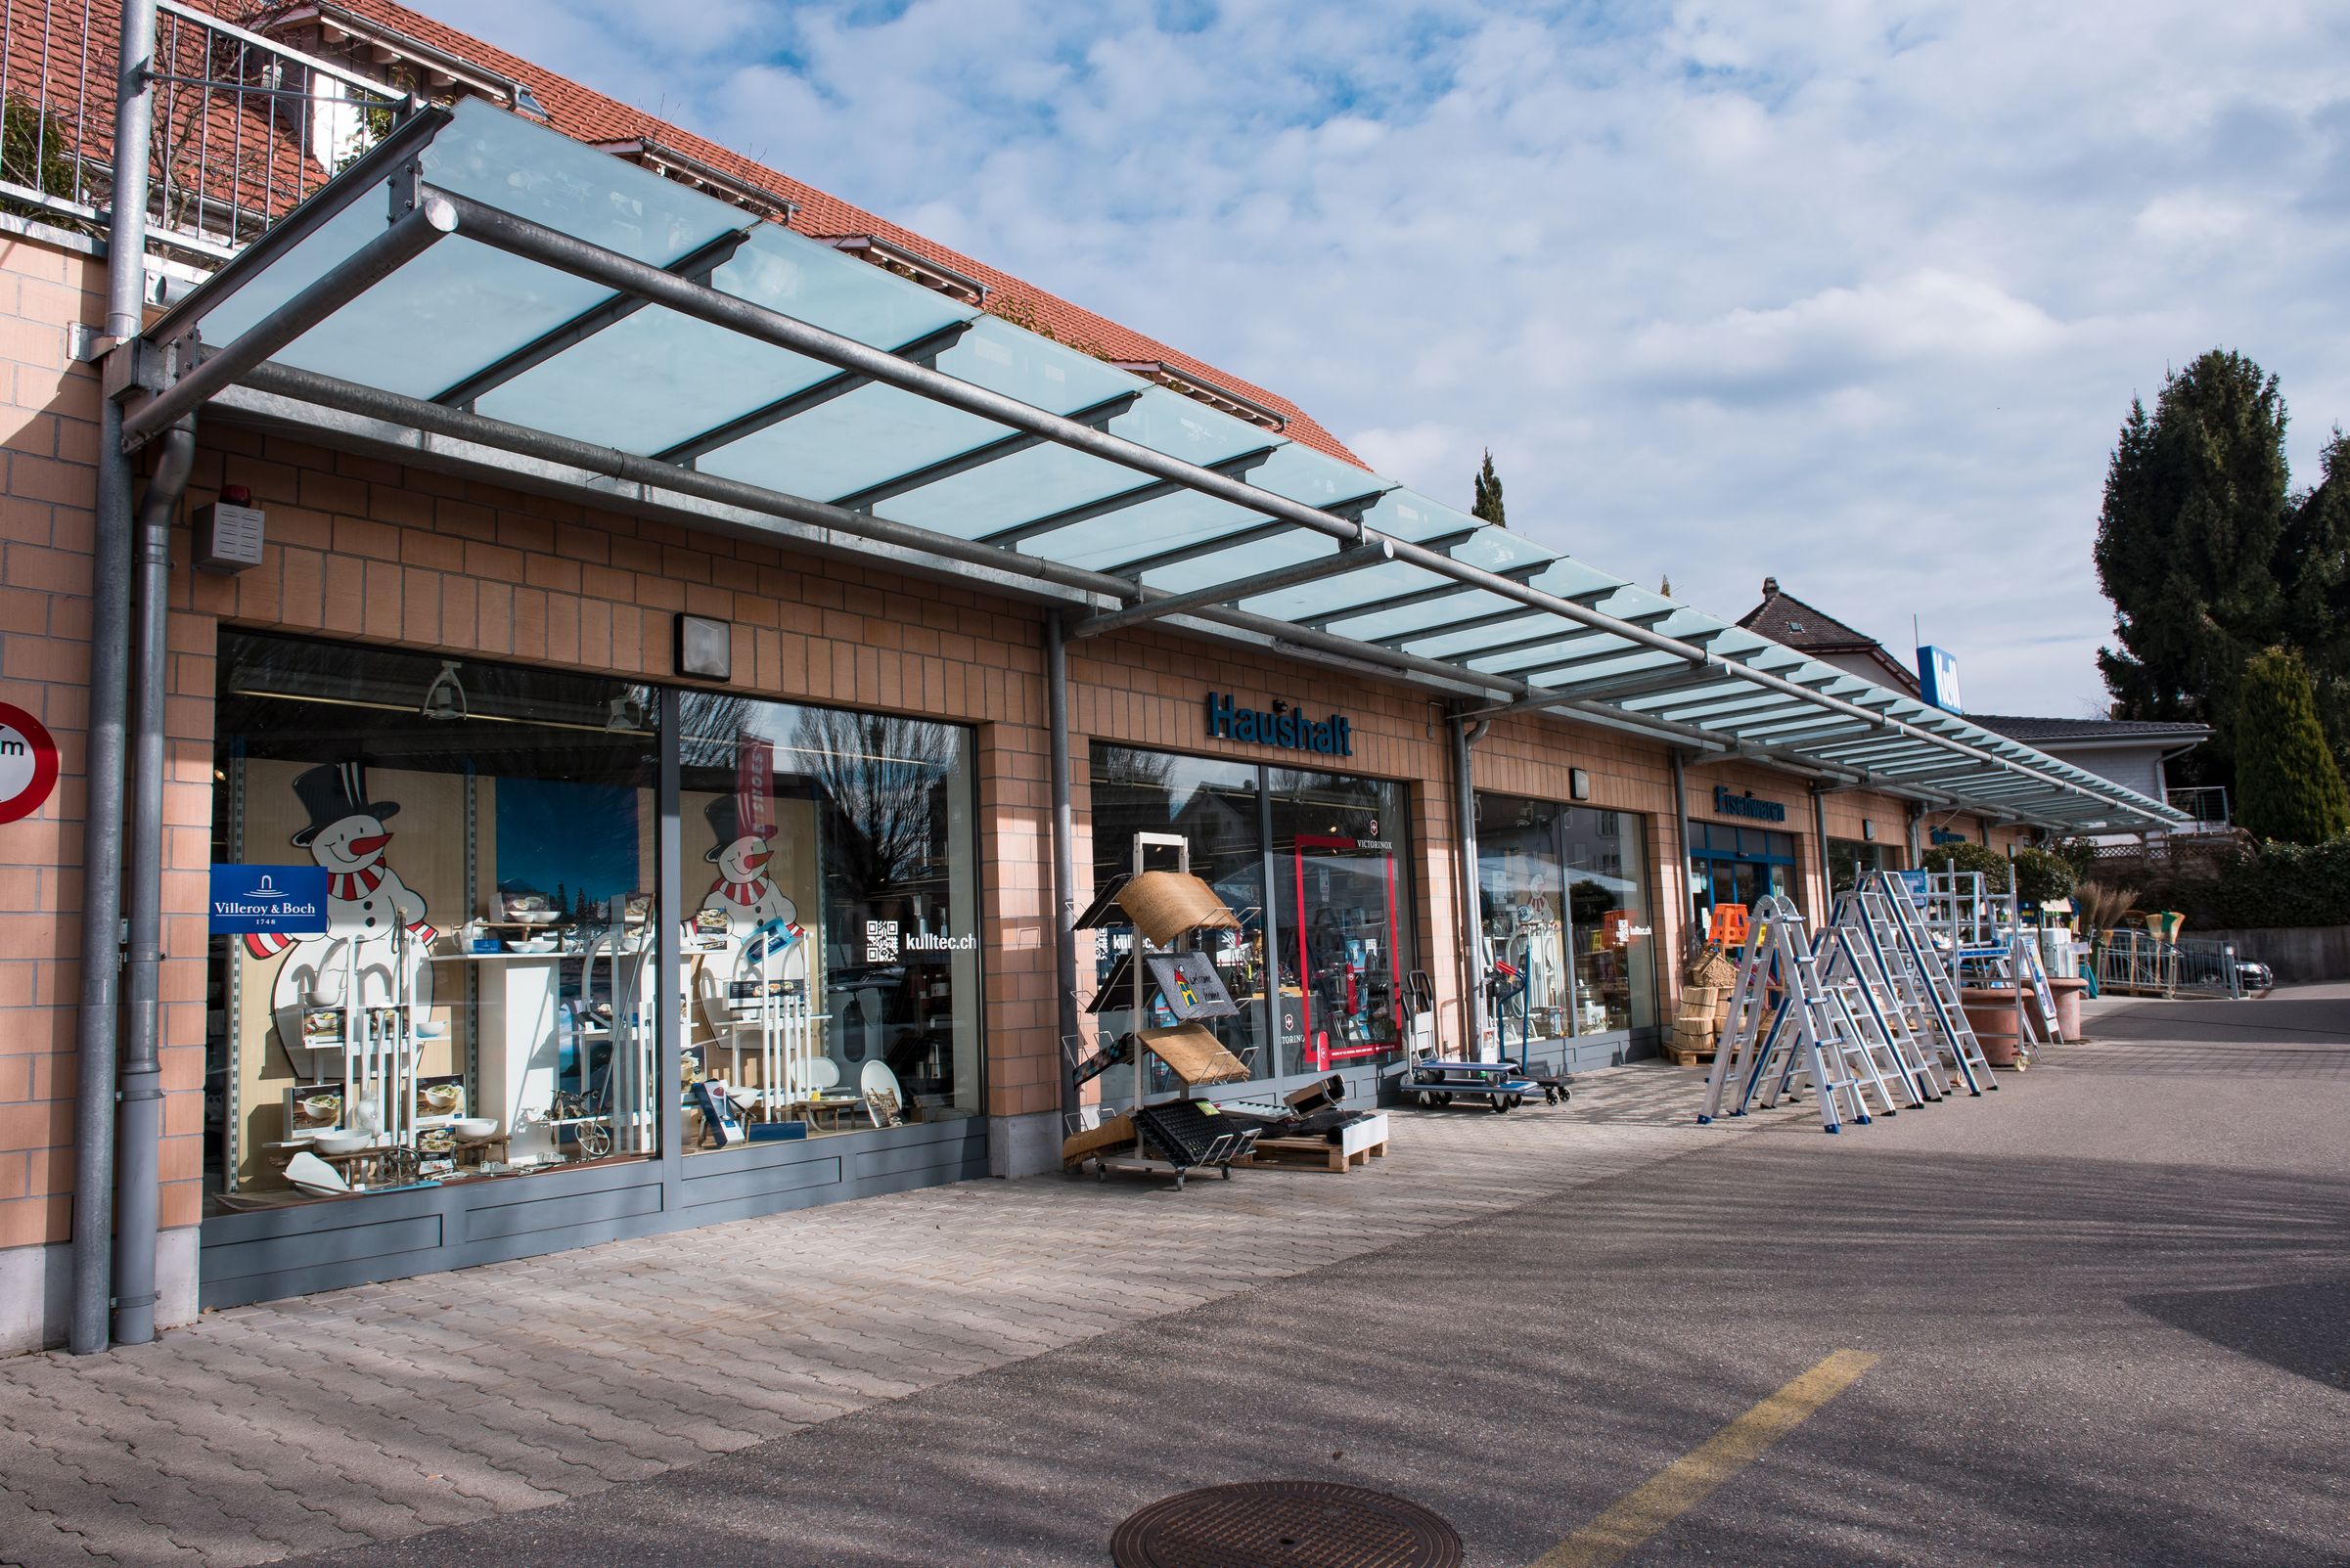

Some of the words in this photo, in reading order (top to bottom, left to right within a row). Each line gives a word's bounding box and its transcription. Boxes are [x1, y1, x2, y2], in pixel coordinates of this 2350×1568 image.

[1932, 650, 1962, 710] Kull
[1208, 692, 1353, 756] Haushalt
[1714, 785, 1785, 822] Eisenwaren
[1357, 839, 1393, 850] VICTORINOX
[214, 902, 268, 917] Villeroy
[271, 904, 280, 914] &
[282, 902, 316, 914] Boch
[906, 933, 977, 950] kulltec.ch
